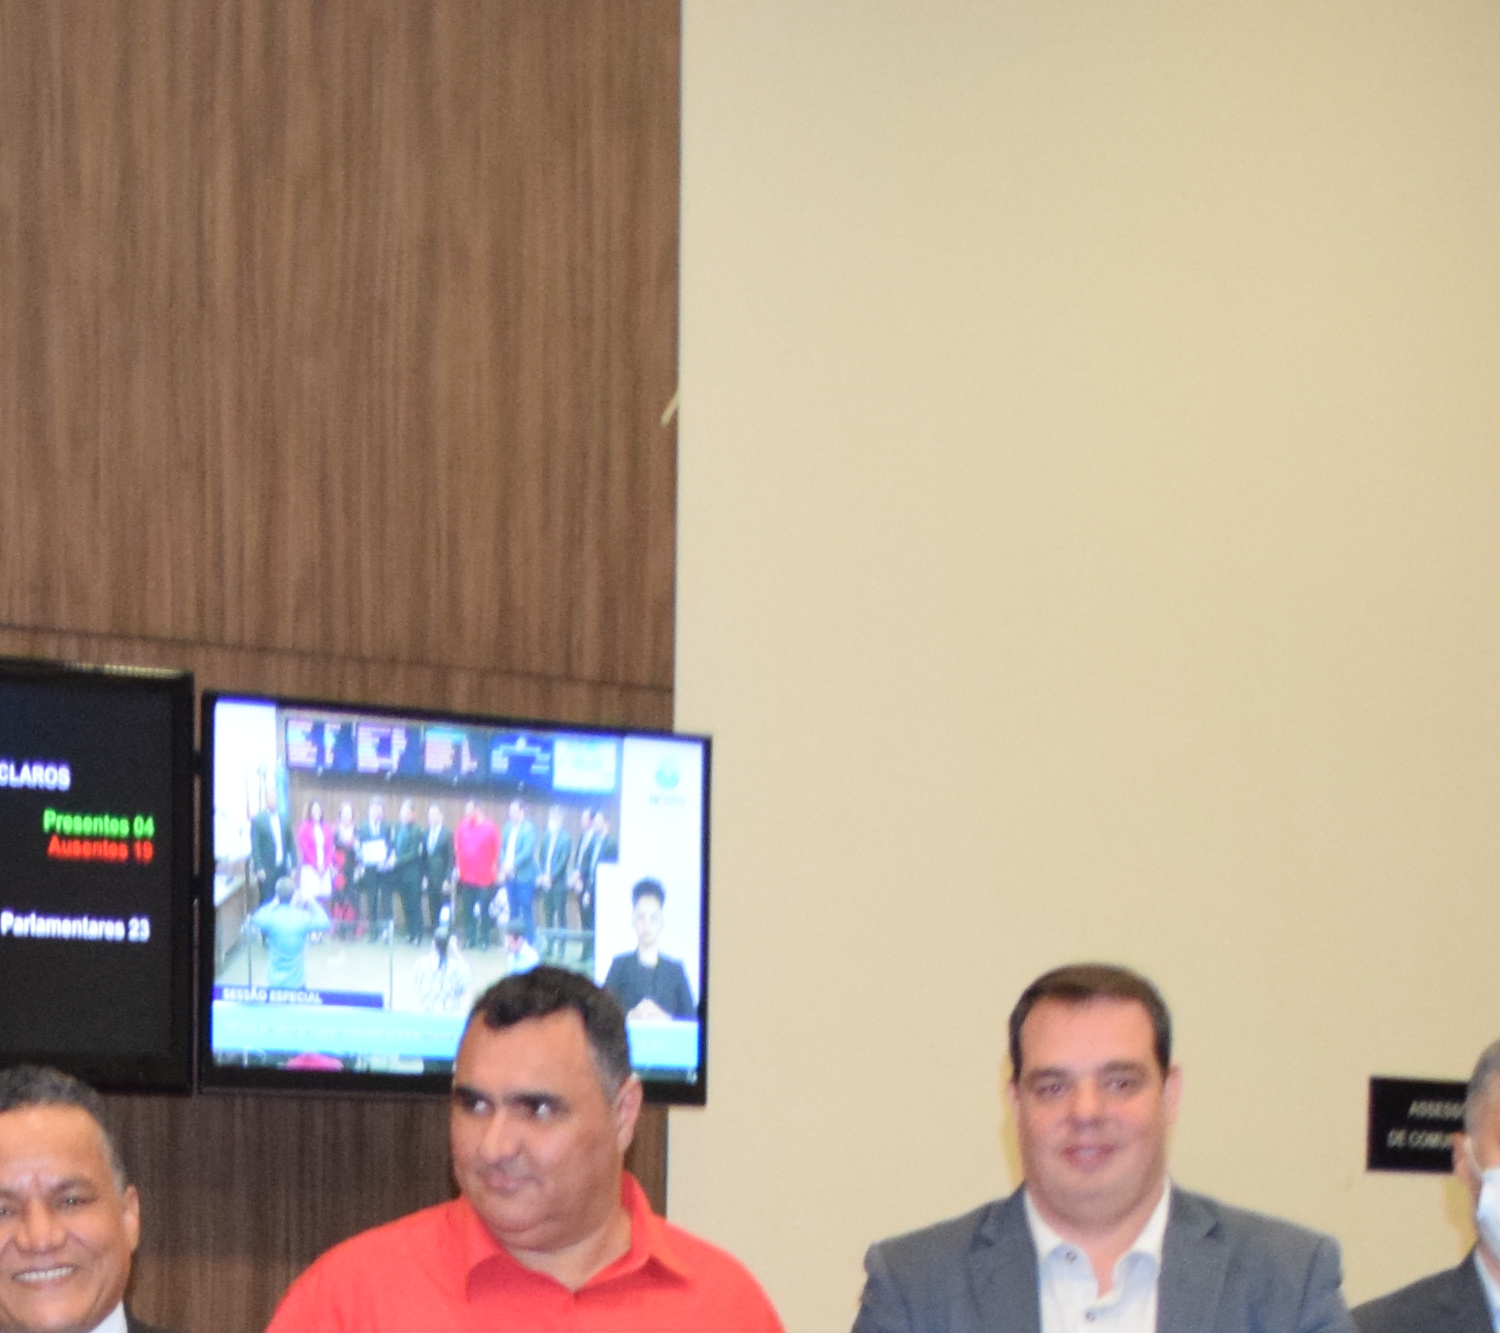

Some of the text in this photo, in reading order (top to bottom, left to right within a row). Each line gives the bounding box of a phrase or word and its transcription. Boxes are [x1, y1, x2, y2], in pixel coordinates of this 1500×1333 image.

[43, 808, 154, 839] Presentes 04
[48, 834, 128, 863] Ausentes
[0, 908, 150, 943] Parlamentares 23
[223, 986, 322, 1004] SESSÃO ESPECIAL
